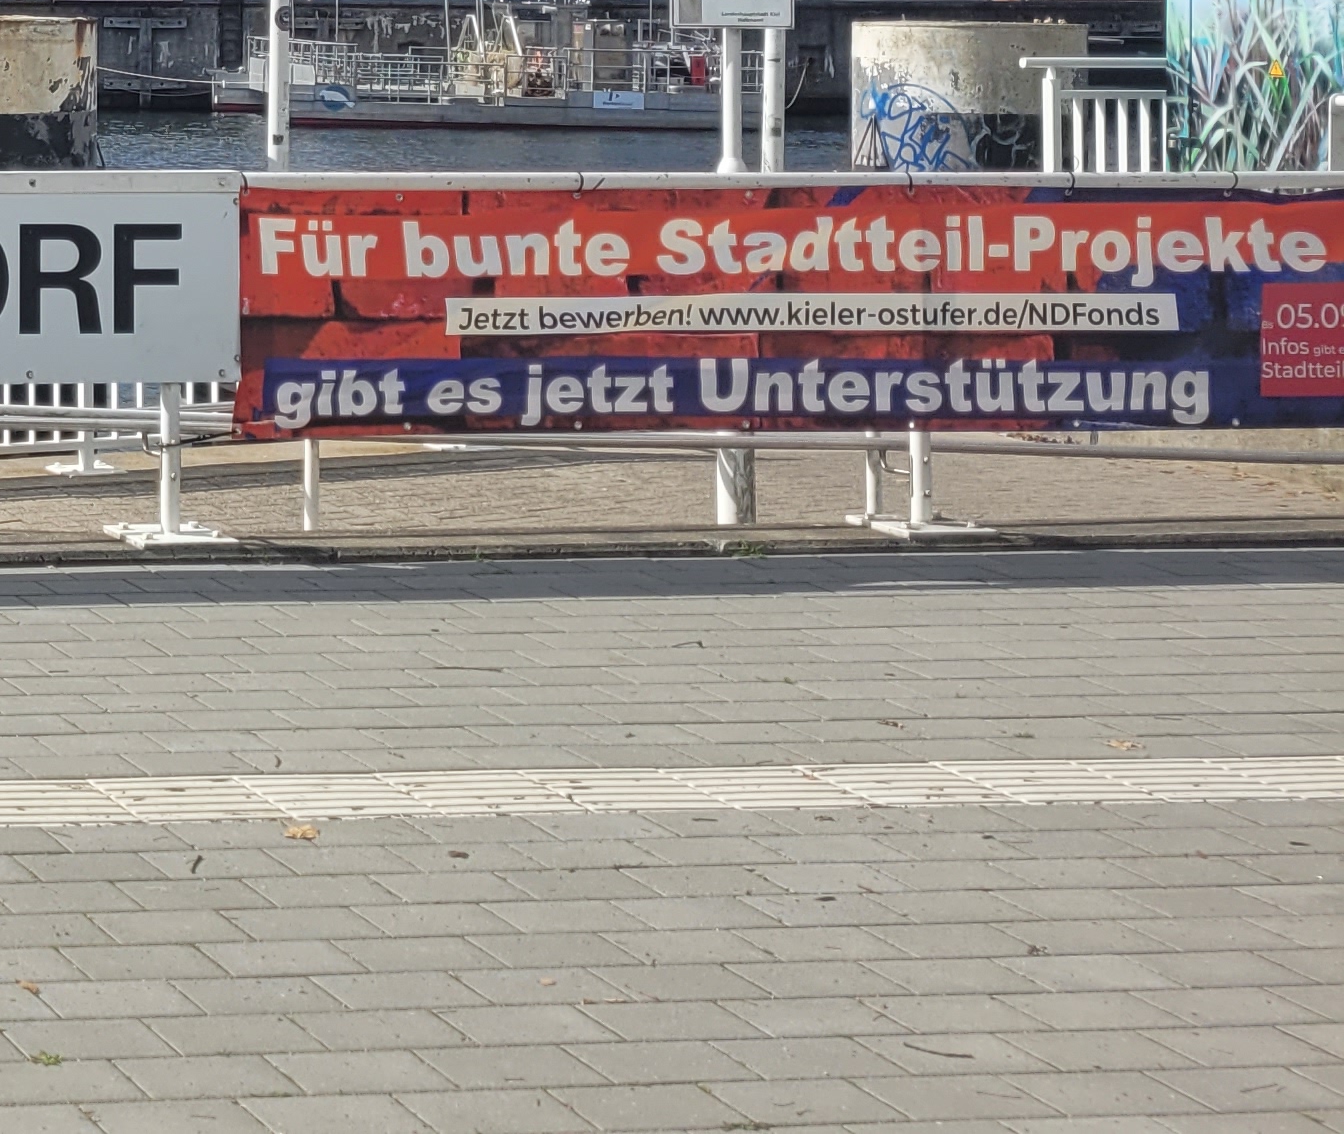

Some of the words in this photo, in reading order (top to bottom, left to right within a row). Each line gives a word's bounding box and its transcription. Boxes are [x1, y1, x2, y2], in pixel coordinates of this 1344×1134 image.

[258, 217, 378, 277] Für
[402, 218, 630, 278] bunte
[656, 215, 1327, 288] Stadtteil-Projekte
[458, 305, 529, 331] Jetzt
[539, 302, 693, 330] bewerben!
[699, 298, 1160, 330] www.kieler-ostufer.de/NDFonds
[1277, 303, 1344, 329] 05.0
[1262, 337, 1310, 355] Infos
[1313, 344, 1336, 357] gibt
[274, 368, 407, 430] gibt
[426, 375, 502, 414] es
[521, 364, 674, 427] jetzt
[699, 357, 1210, 425] Unterstützung
